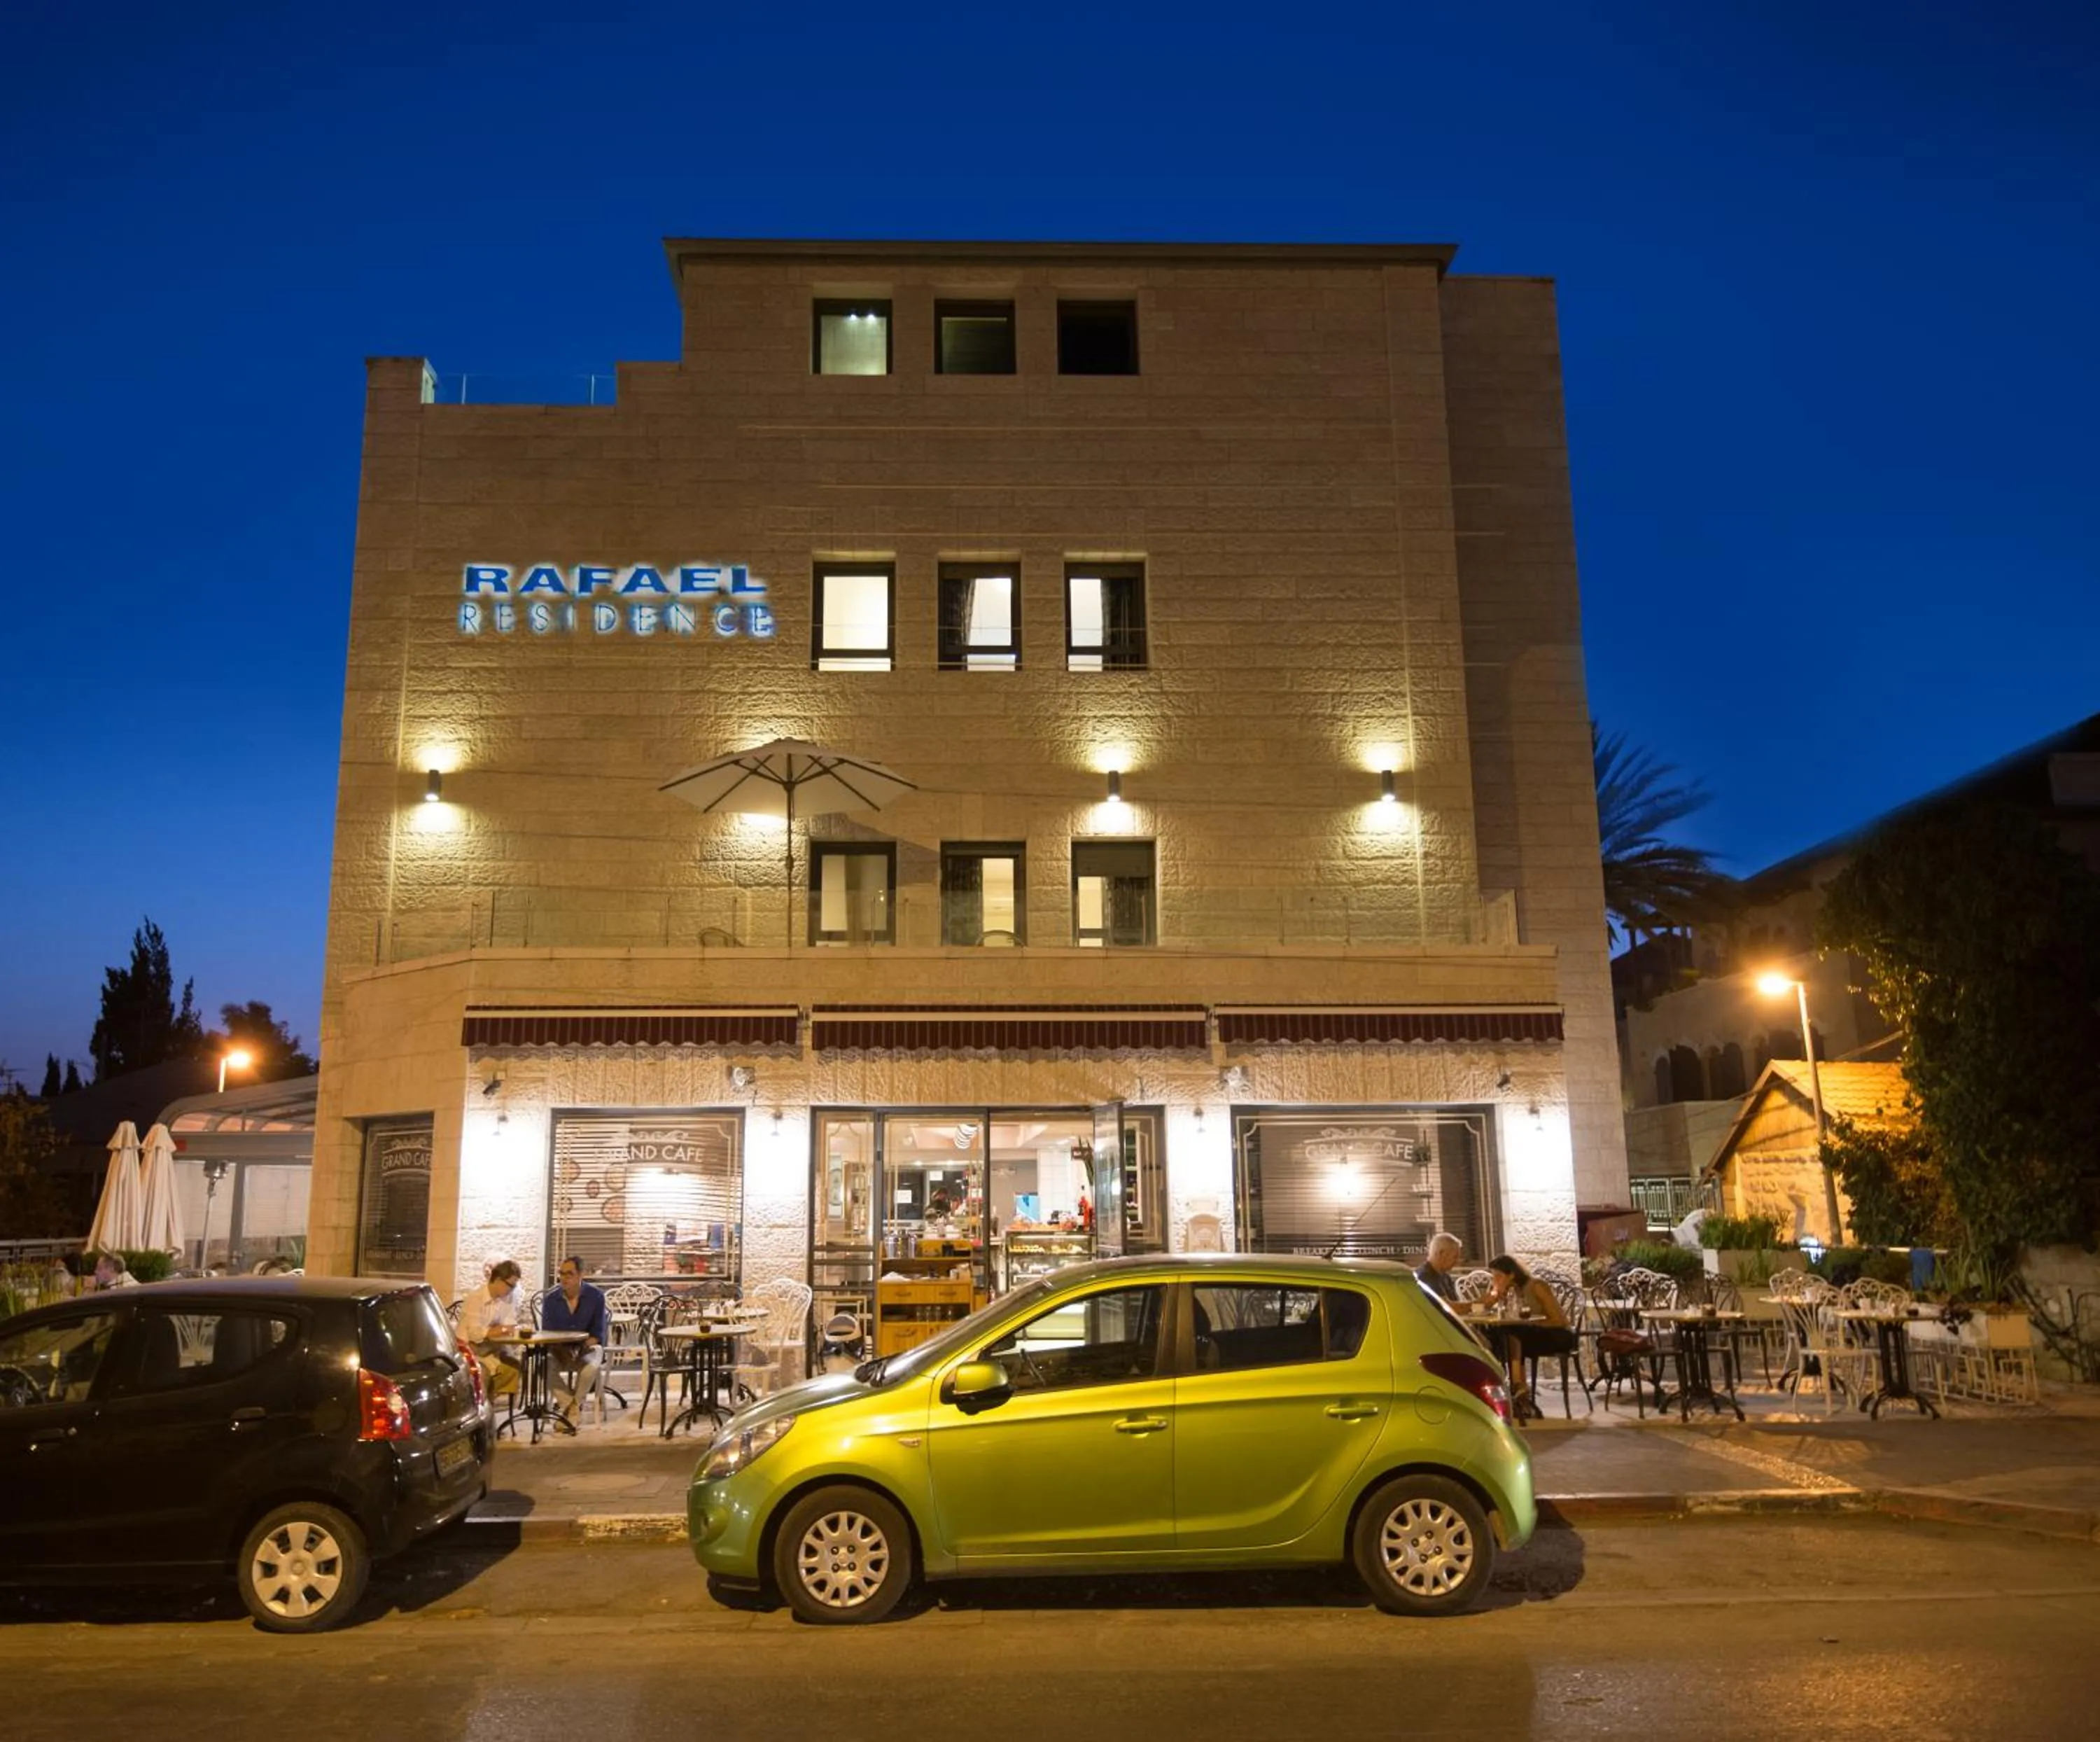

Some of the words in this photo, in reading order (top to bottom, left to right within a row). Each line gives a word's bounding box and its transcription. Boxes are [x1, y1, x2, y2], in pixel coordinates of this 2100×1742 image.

[463, 566, 767, 593] RAFAEL
[461, 603, 773, 632] RESIDENCE
[382, 1152, 412, 1170] GRAND
[595, 1145, 657, 1164] RAND
[662, 1145, 705, 1162] CAFE
